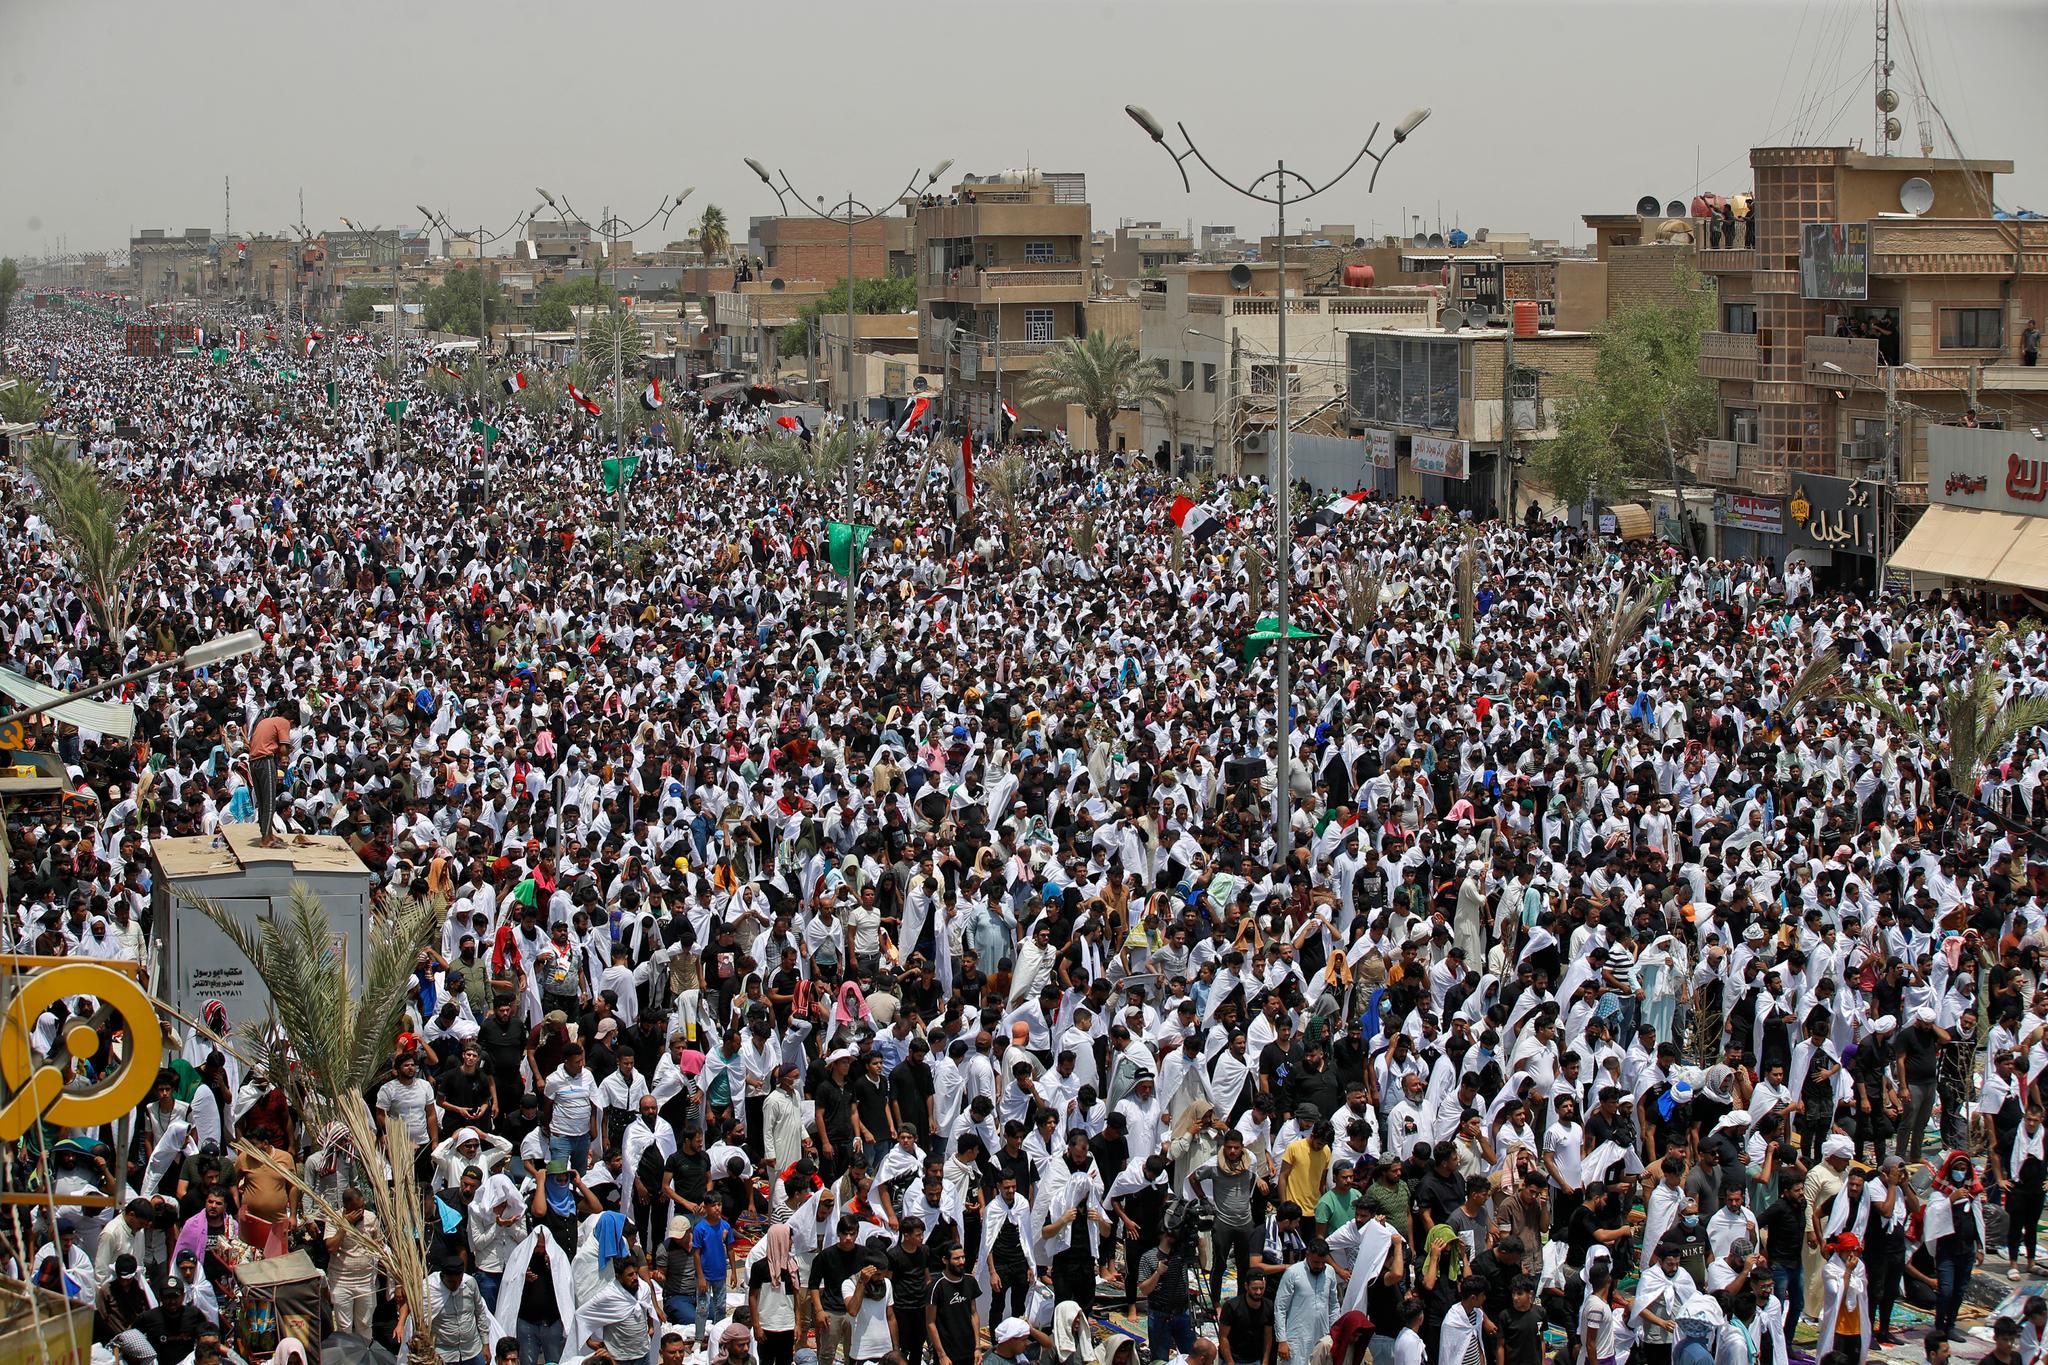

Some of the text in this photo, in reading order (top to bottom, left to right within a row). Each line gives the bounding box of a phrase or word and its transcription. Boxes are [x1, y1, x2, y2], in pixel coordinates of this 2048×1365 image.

[1810, 509, 1860, 549] الجبل
[193, 968, 212, 979] رسول
[224, 967, 243, 978] مكتب
[1682, 1246, 1704, 1257] NIKE
